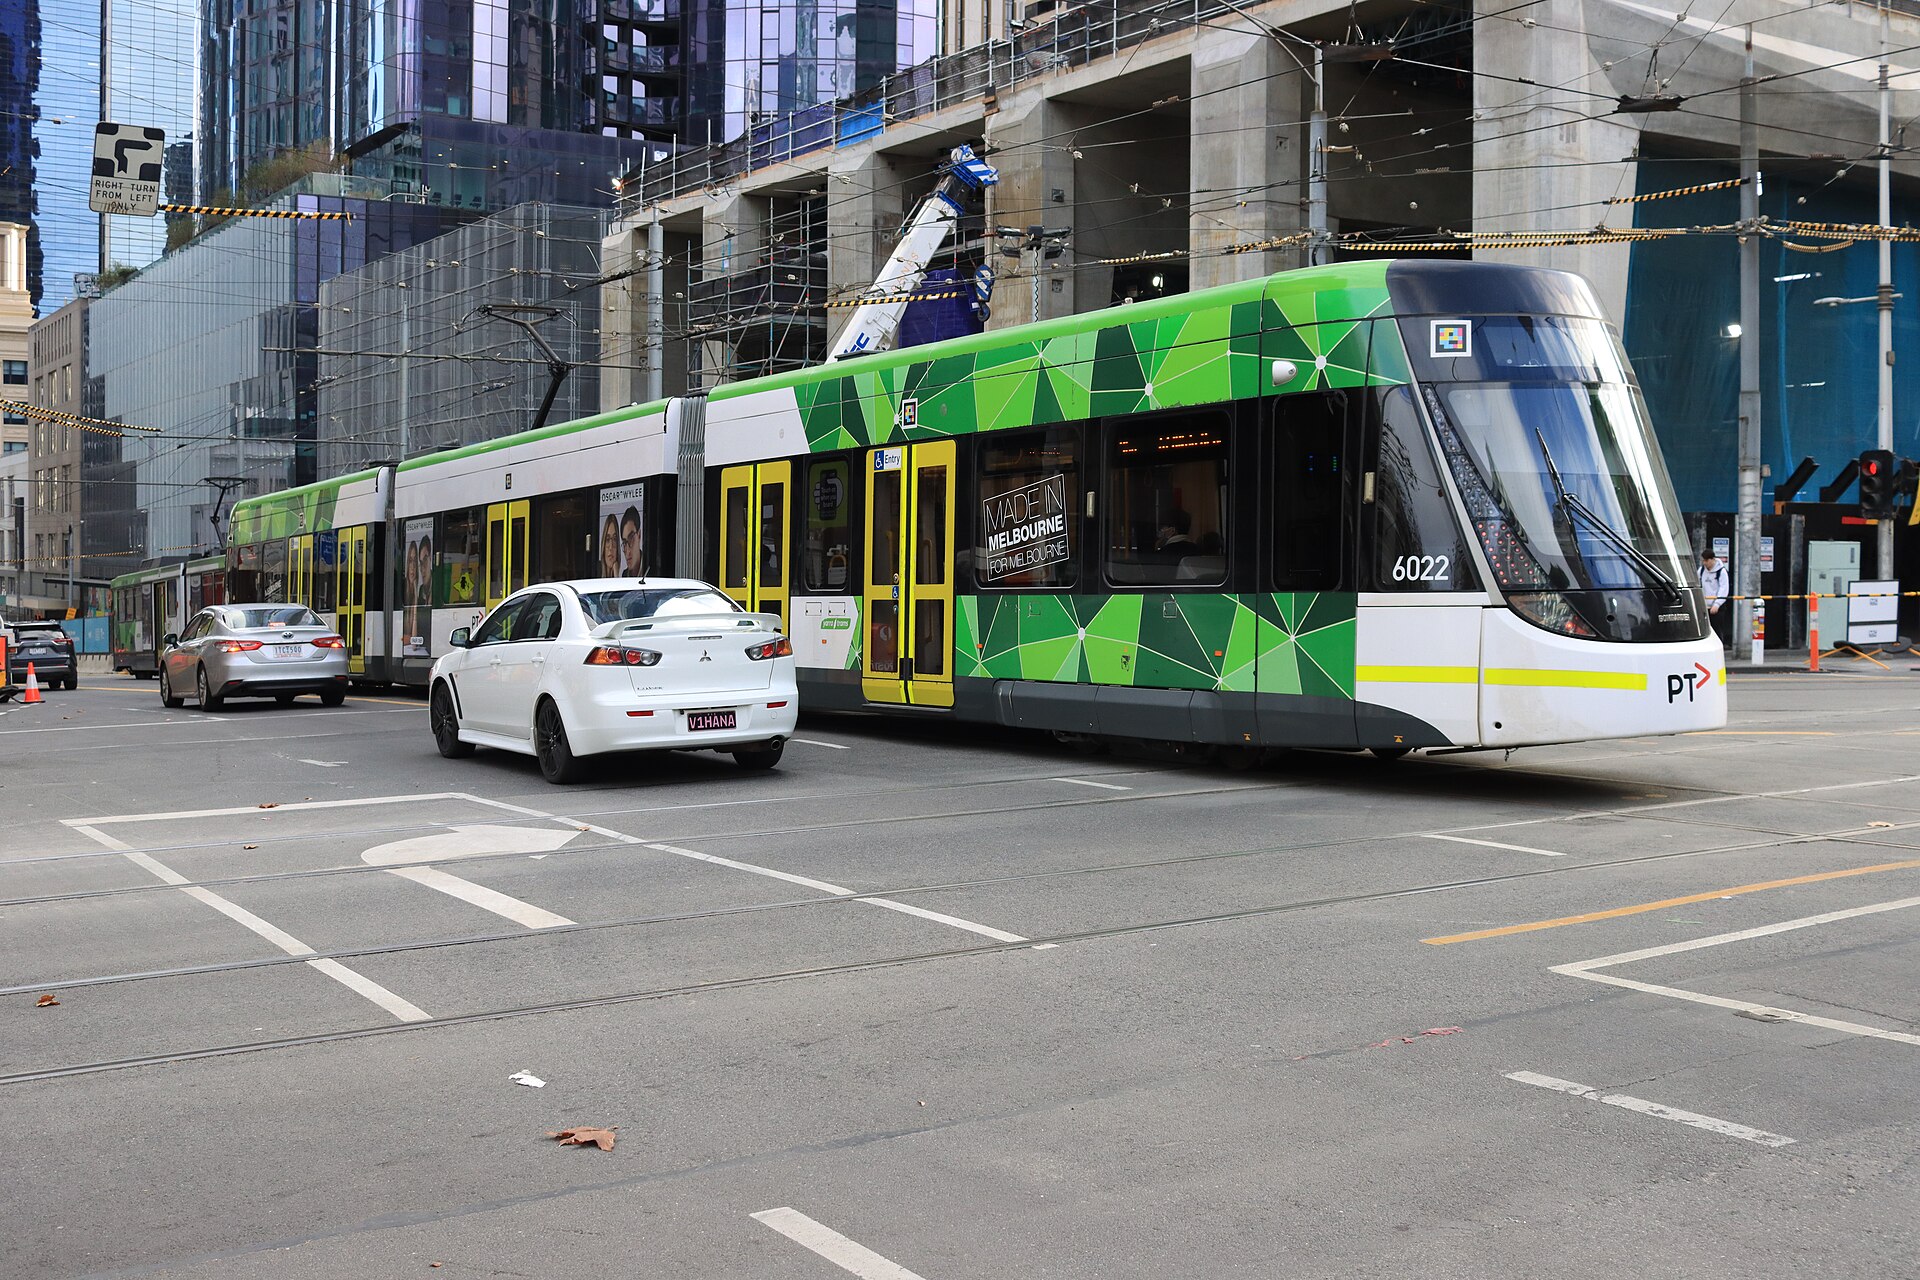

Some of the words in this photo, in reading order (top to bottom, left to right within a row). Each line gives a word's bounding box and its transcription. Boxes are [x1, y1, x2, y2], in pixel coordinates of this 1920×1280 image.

[95, 180, 123, 190] RIGHT
[131, 184, 156, 192] TURN
[96, 190, 122, 199] FROM
[130, 194, 153, 202] LEFT
[111, 202, 137, 210] ONLY
[885, 455, 900, 465] Entry
[602, 491, 620, 502] OSCAR
[623, 487, 643, 499] WYLEE
[986, 487, 1041, 532] MADE
[1044, 480, 1063, 514] IN
[988, 514, 1064, 552] MELBOURNE
[989, 557, 1009, 575] FOR
[1009, 540, 1066, 570] MELBOURNE
[1392, 555, 1449, 581] 6022
[1667, 673, 1698, 704] PT
[689, 714, 736, 729] V1HANA
